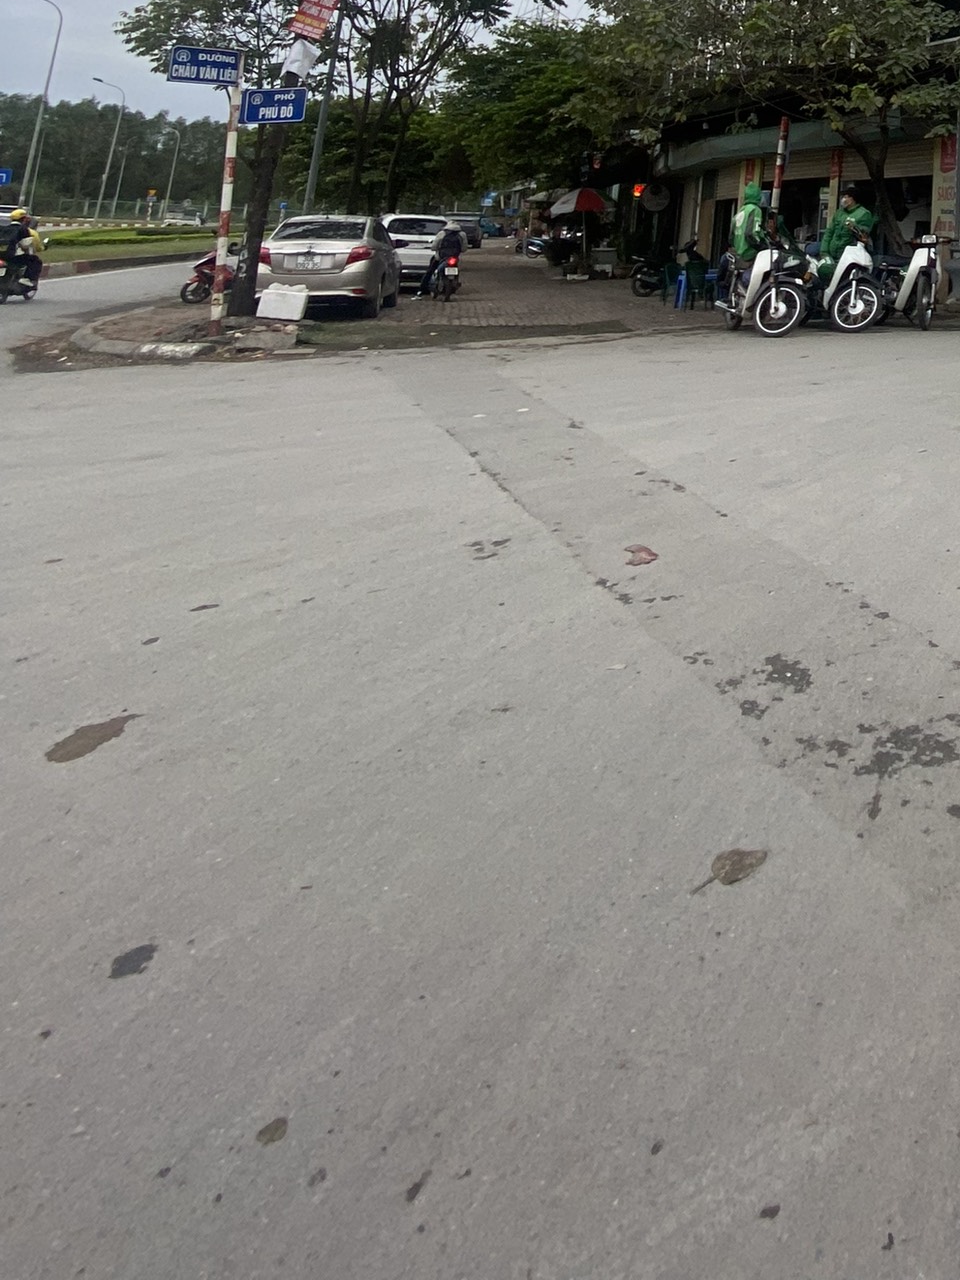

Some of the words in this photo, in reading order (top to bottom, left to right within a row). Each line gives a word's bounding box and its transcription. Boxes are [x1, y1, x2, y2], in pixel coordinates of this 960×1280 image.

[198, 52, 236, 64] ĐƯỜNG
[172, 64, 197, 78] CHÂU
[200, 65, 217, 80] VĂN
[274, 90, 295, 100] PHỐ
[259, 104, 278, 119] PHÚ
[280, 103, 293, 118] ĐÔ
